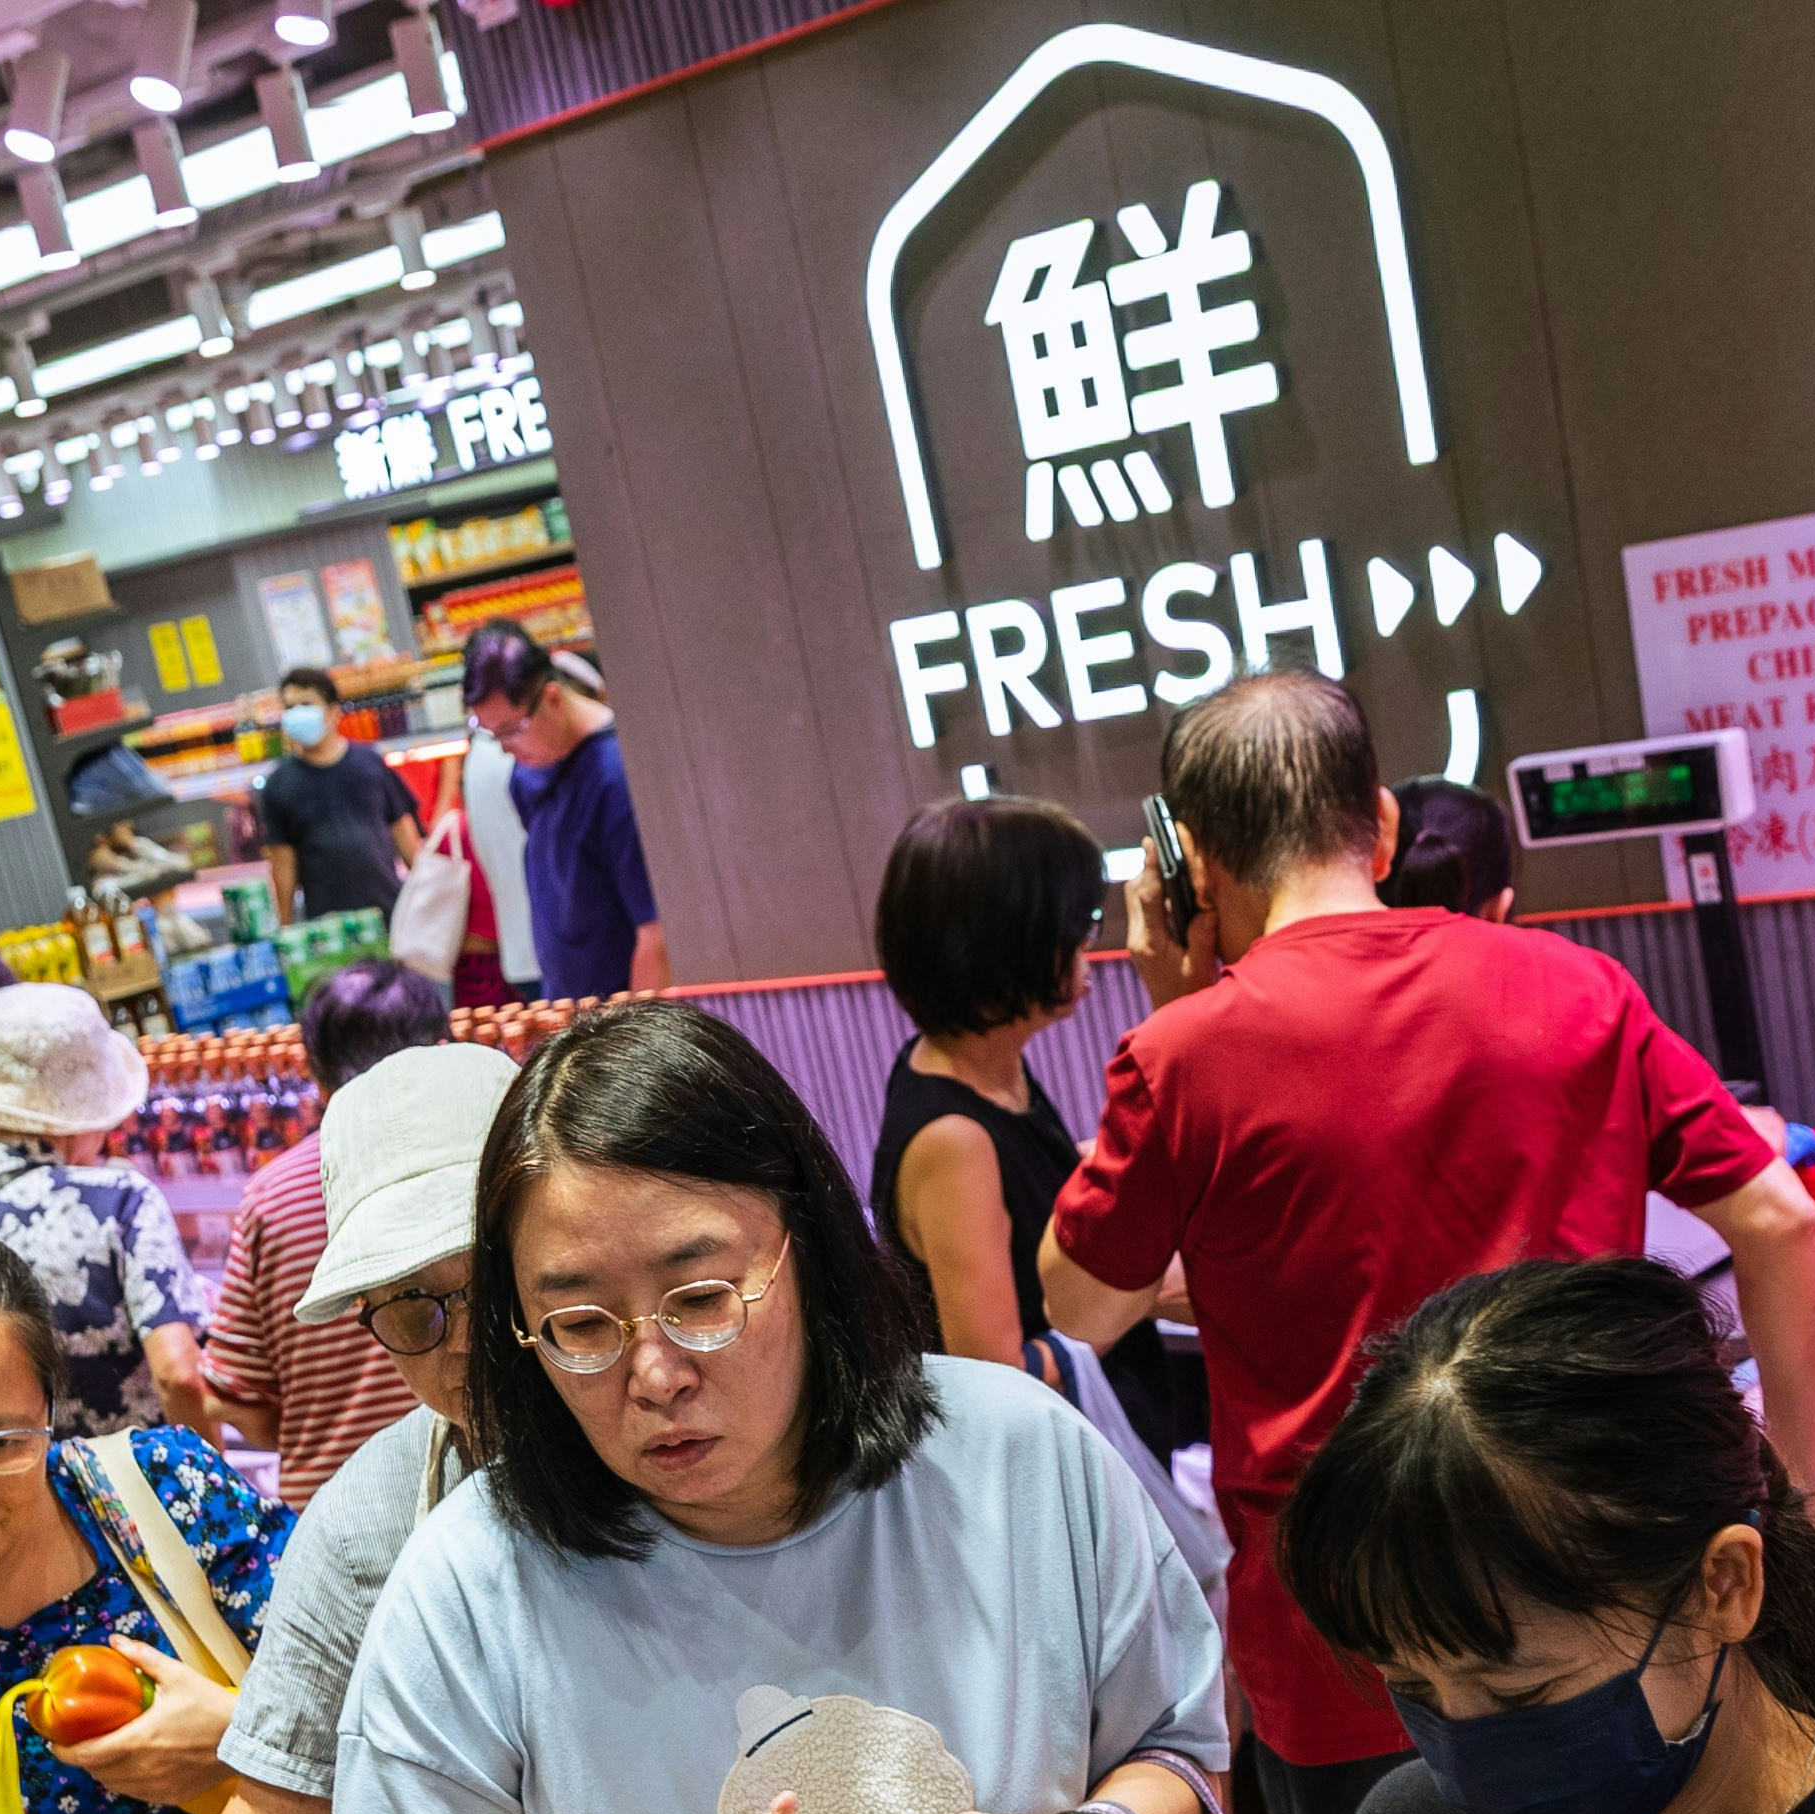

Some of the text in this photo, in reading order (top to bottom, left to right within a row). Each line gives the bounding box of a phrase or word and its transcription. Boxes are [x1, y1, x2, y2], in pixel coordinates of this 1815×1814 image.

[985, 179, 1280, 542] 鮮
[446, 375, 554, 472] FRE
[1651, 554, 1770, 605] FRESH
[890, 538, 1345, 749] FRESH
[1684, 694, 1787, 734] MEAT
